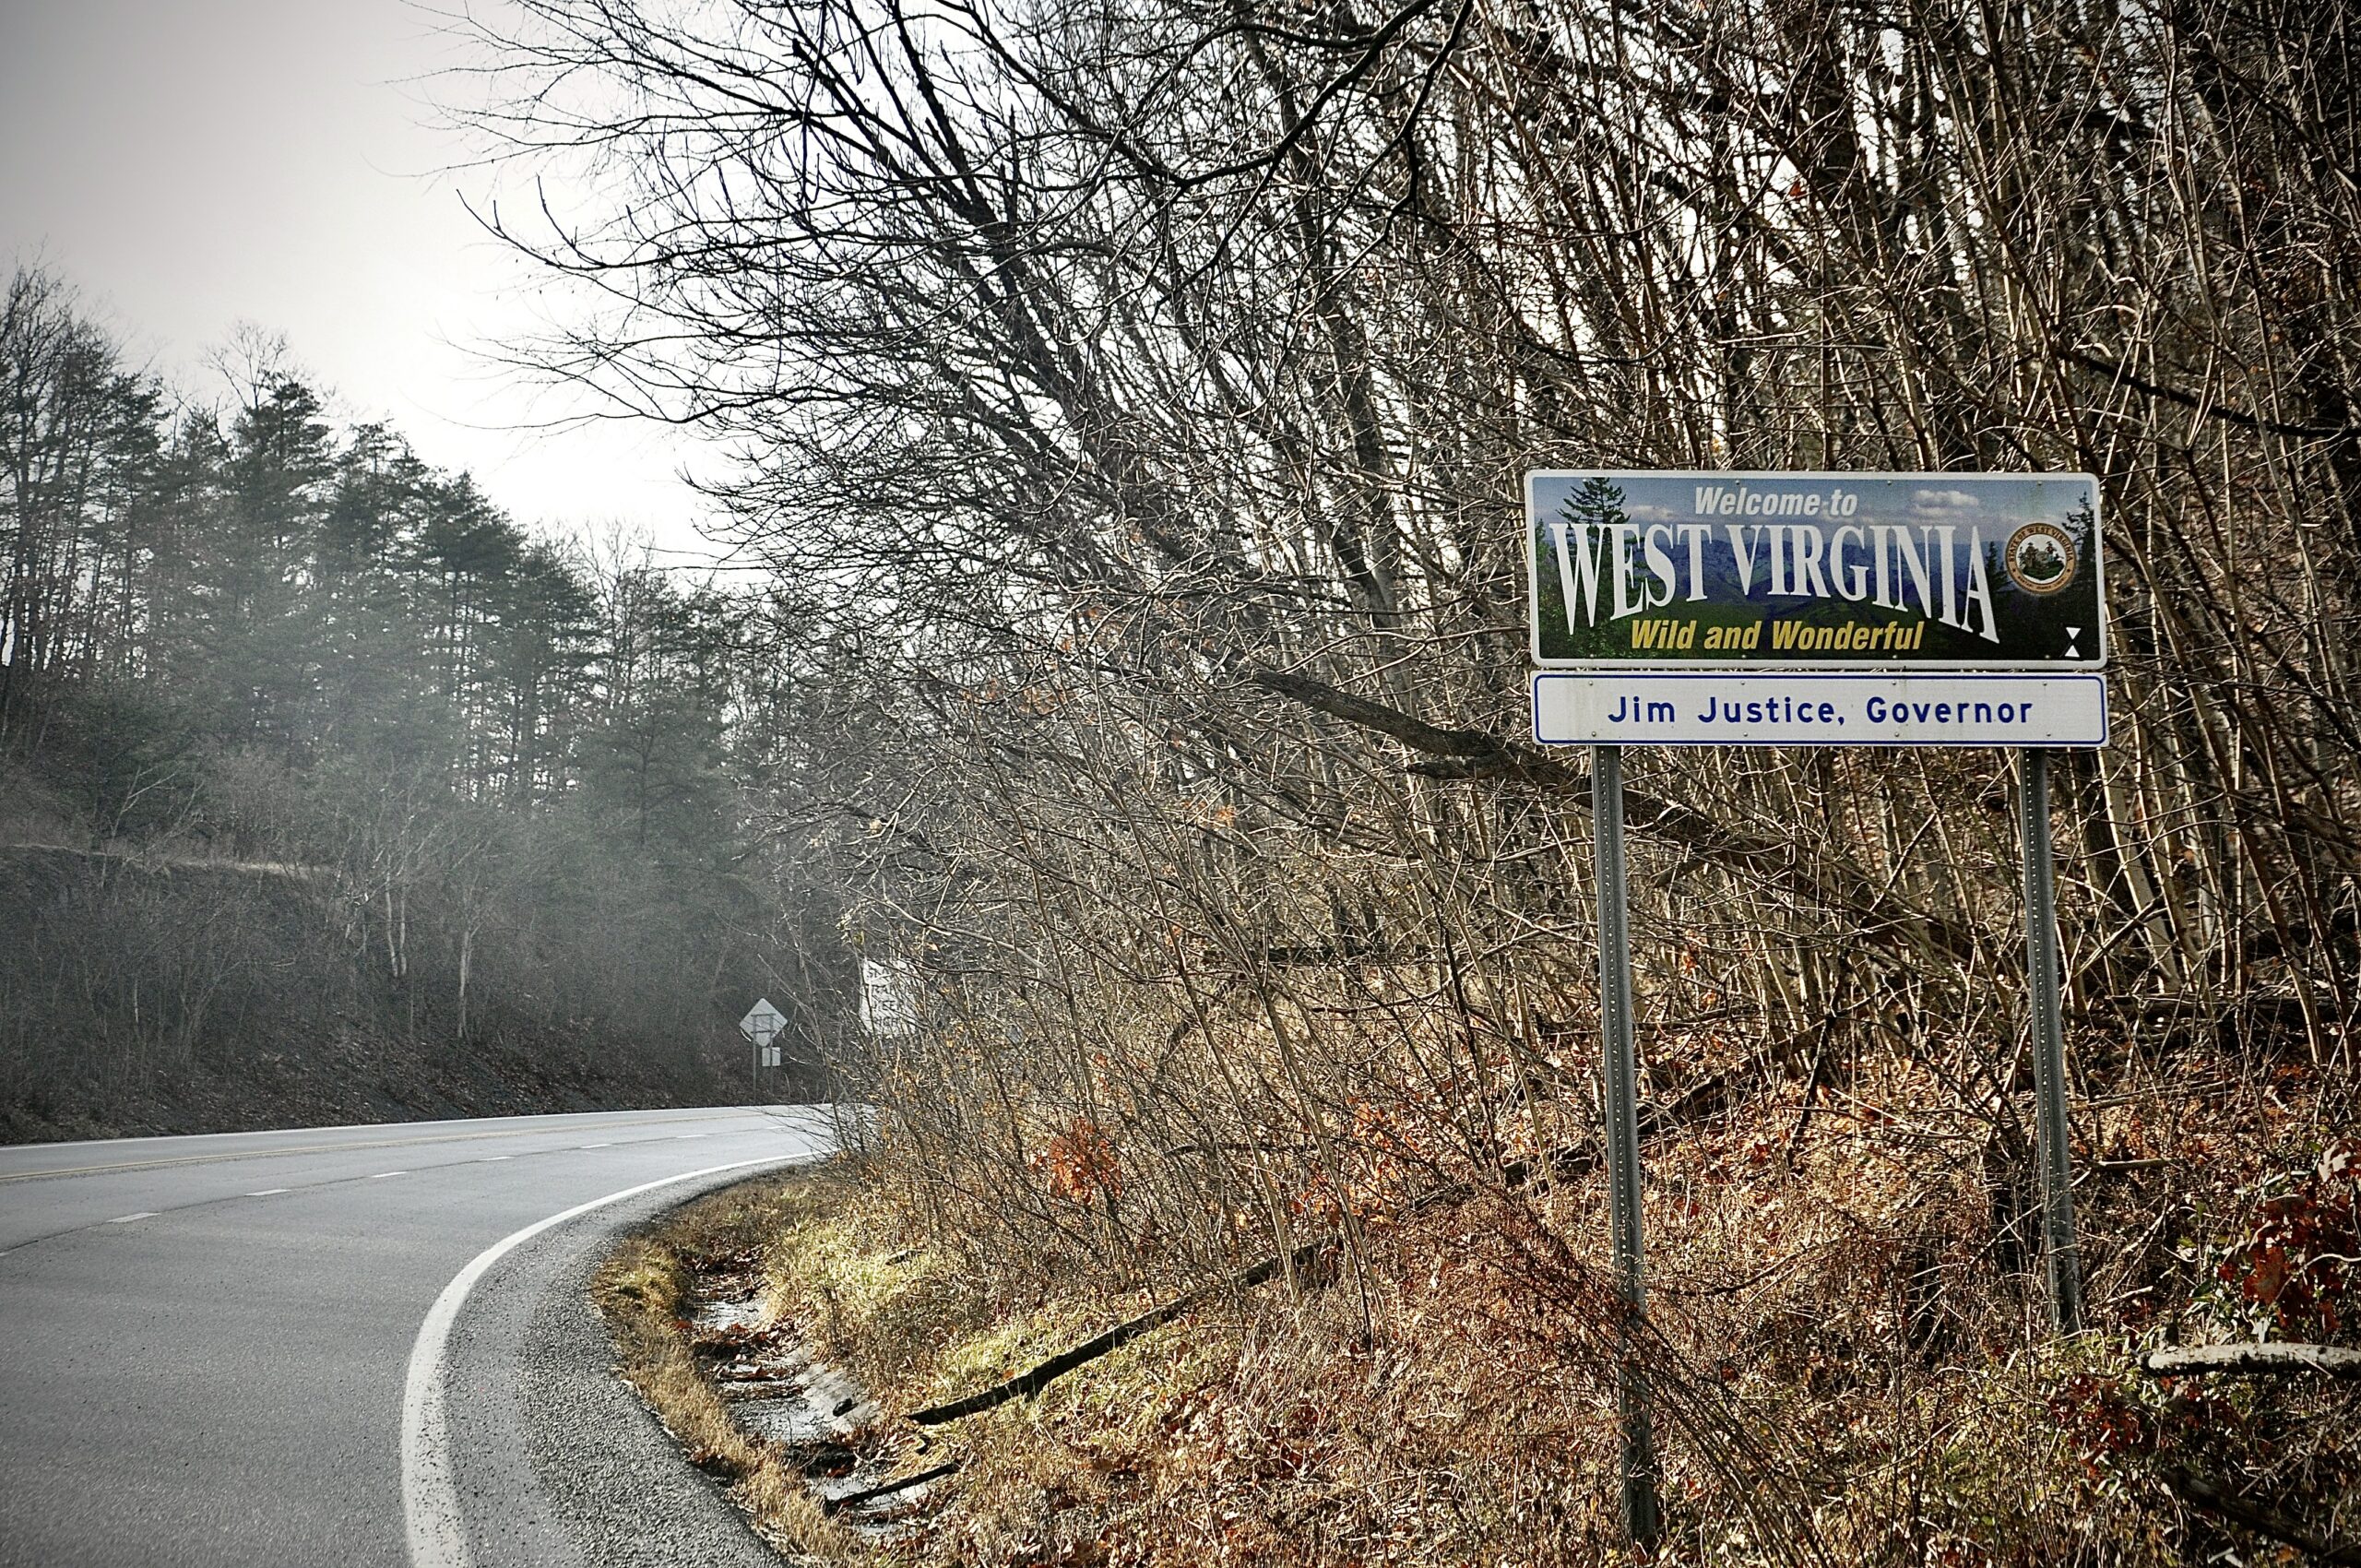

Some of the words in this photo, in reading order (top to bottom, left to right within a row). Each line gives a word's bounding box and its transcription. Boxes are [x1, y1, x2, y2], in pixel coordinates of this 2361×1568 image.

[1695, 486, 1821, 517] Welcome
[1830, 488, 1858, 517] to
[1549, 522, 1712, 636] WEST
[1725, 524, 1999, 644] VIRGINIA
[1631, 620, 1697, 649] Wild
[1703, 621, 1762, 650] and
[1771, 621, 1926, 651] Wonderful
[1608, 695, 1676, 723] Jim
[1697, 696, 1845, 726] Justice,
[1865, 696, 2034, 724] Governor
